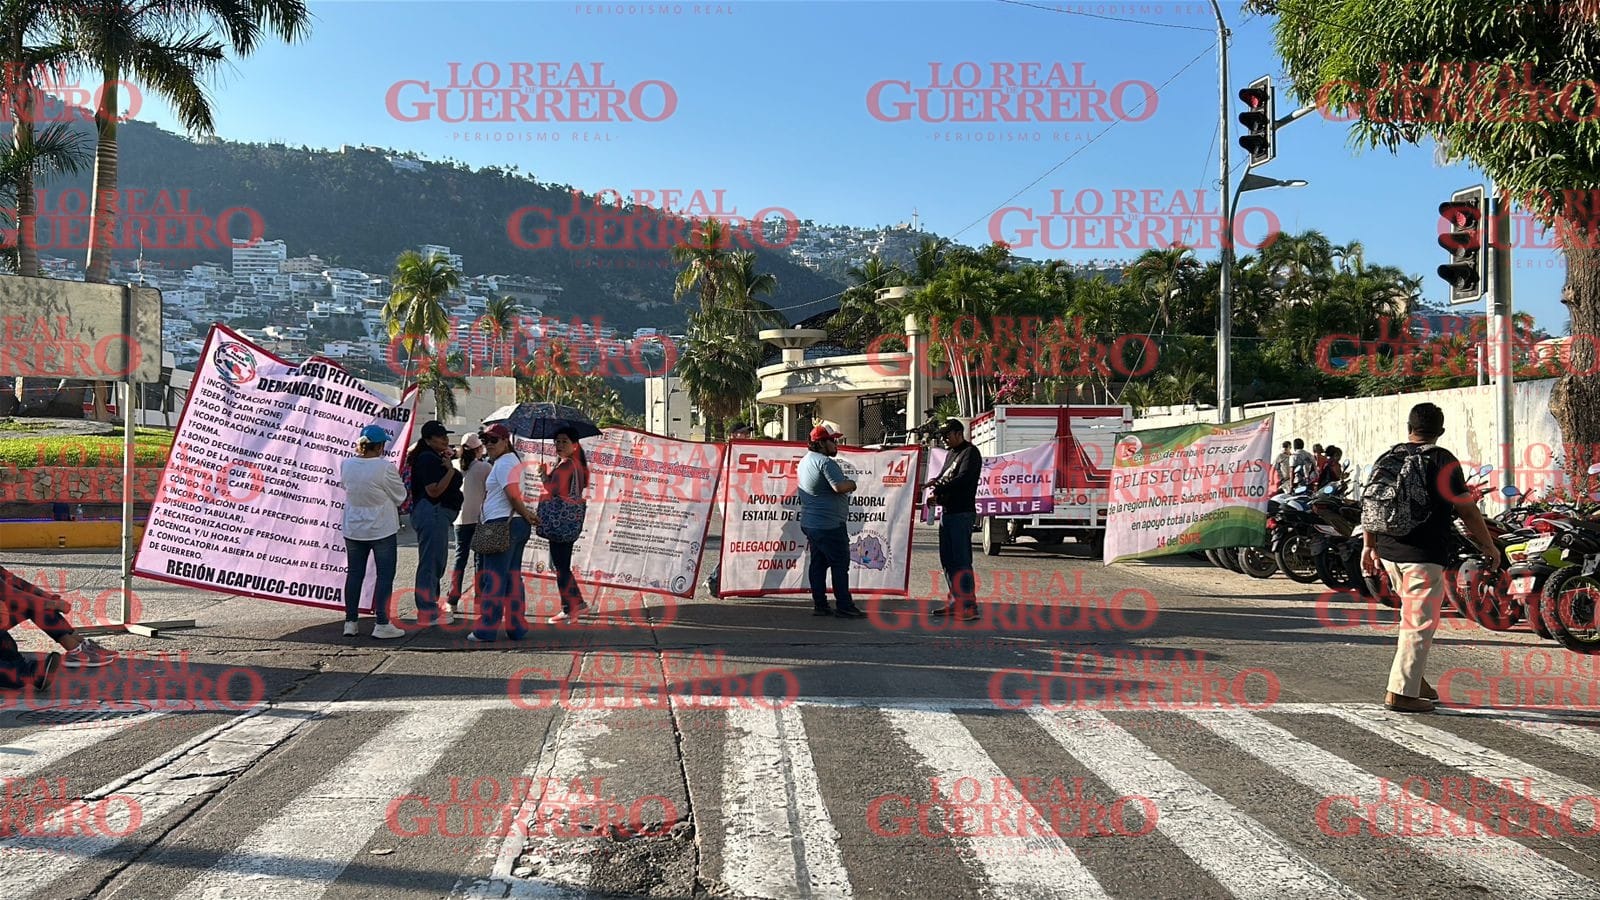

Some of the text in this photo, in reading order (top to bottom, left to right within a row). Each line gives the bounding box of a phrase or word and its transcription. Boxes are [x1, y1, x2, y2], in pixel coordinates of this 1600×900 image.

[201, 388, 283, 420] FEDERALIZADA (FONE)
[206, 378, 272, 405] INCORPORACIÓN
[274, 400, 297, 411] TOTAL
[297, 406, 311, 415] DEL
[258, 378, 325, 400] DEMANDAS
[325, 388, 343, 406] DEL
[344, 394, 380, 417] NIVEL
[192, 421, 220, 436] FORMA.
[199, 400, 220, 412] PAGO
[222, 408, 232, 417] DE
[234, 412, 282, 431] QUINCENAS,
[326, 435, 350, 446] BONO
[184, 442, 205, 454] PAGO
[207, 450, 218, 458] DE
[220, 454, 229, 463] LA
[232, 458, 278, 474] COBERTURA
[188, 432, 209, 444] BONO
[211, 440, 263, 459] DECEMBRINO
[264, 454, 282, 463] QUE
[283, 458, 297, 467] SEA
[1163, 449, 1174, 458] de
[1208, 445, 1238, 454] CT-595
[176, 452, 227, 473] COMPAÑEROS
[229, 468, 246, 478] QUE
[887, 460, 904, 475] 14
[1114, 459, 1263, 490] TELESECUNDARIAS
[170, 475, 198, 488] CÓDIGO
[201, 482, 211, 492] 10
[994, 474, 1051, 484] ESPECIAL
[216, 476, 227, 485] DE
[229, 480, 266, 494] CARRERA
[330, 500, 345, 509] TOD
[747, 494, 802, 505] APOYO TOTA
[848, 496, 886, 506] LABORAL
[992, 487, 1009, 495] 004
[1116, 502, 1122, 512] la
[1218, 486, 1264, 498] HUITZUCO
[163, 497, 245, 523] 07(SUELDO TABULAR).
[170, 487, 236, 510] INCORPORACIÓN
[250, 507, 260, 515] LA
[262, 508, 308, 525] PERCEPCIÓN
[742, 511, 793, 521] ESTATAL DE
[848, 512, 887, 522] ESPECIAL
[935, 501, 1041, 517] PSENTE
[153, 518, 241, 544] DOCENCIA Y/U HORAS.
[163, 509, 242, 533] RECATEGORIZACION
[243, 527, 254, 535] DE
[256, 530, 297, 545] PERSONAL
[1131, 521, 1140, 530] en
[1142, 518, 1165, 531] apoyo
[1167, 513, 1185, 525] total
[1192, 512, 1198, 522] la
[148, 529, 154, 537] 8.
[157, 531, 219, 551] CONVOCATORIA
[222, 544, 254, 558] ABIERTA
[256, 552, 267, 560] DE
[269, 555, 299, 567] USICAM
[300, 560, 308, 568] EN
[149, 541, 202, 560] DE GUERRERO.
[730, 541, 796, 553] DELEGACION D
[1157, 536, 1165, 547] 14
[1167, 534, 1179, 546] del
[758, 559, 797, 570] ZONA 04
[166, 559, 342, 602] REGIÓN ACAPULCO-COYUCA
